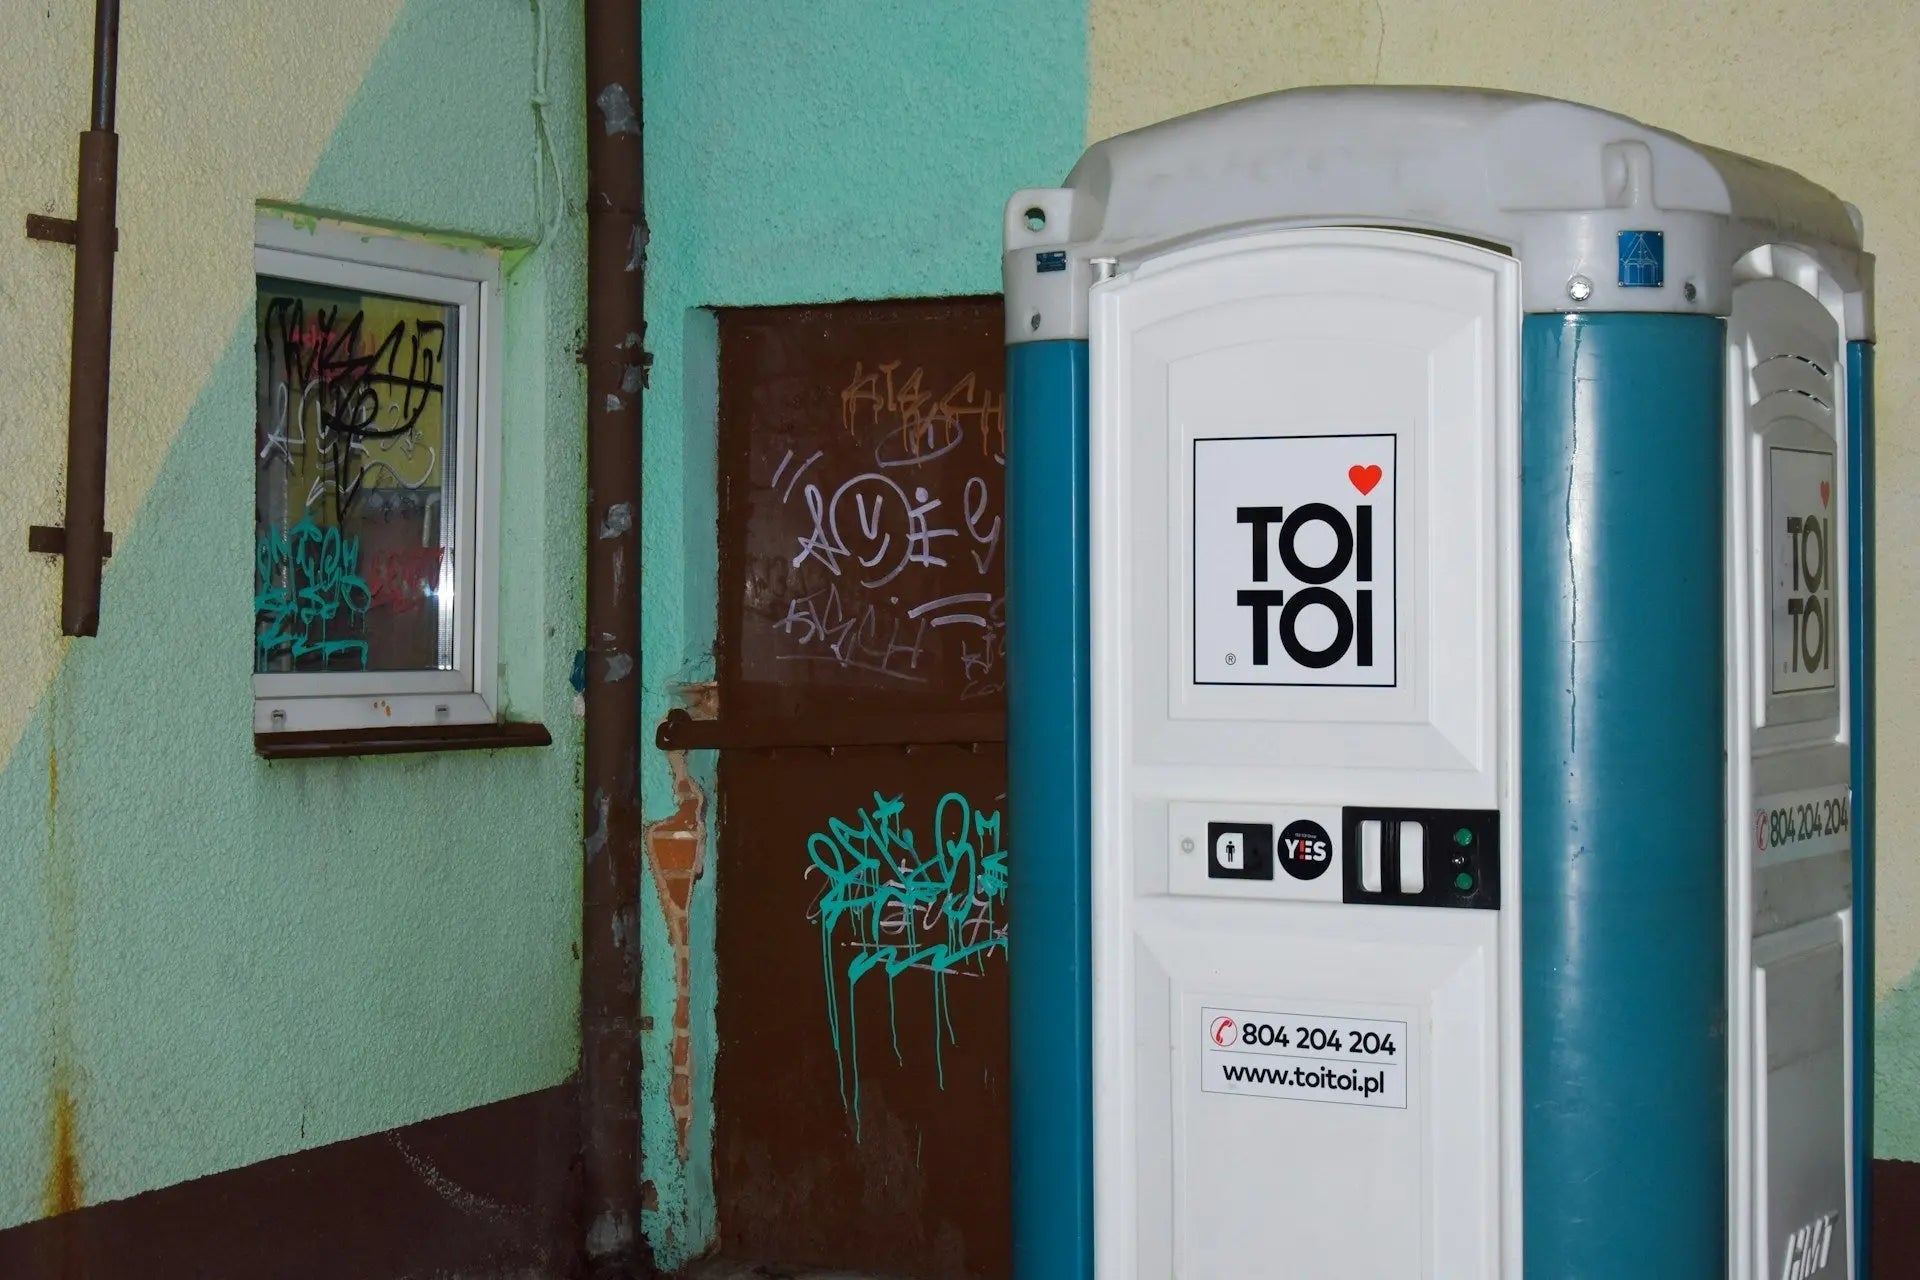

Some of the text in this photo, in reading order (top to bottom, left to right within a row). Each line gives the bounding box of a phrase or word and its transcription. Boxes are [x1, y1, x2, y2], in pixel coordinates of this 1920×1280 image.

[1236, 502, 1373, 585] TOI
[1786, 514, 1829, 594] TOI
[1236, 586, 1373, 669] TOI
[1787, 594, 1829, 674] TOI
[1284, 838, 1327, 862] YES
[1770, 796, 1849, 848] 804 204 204
[1241, 1022, 1397, 1056] 804 204 204
[1222, 1065, 1385, 1098] www.toitoi.pl
